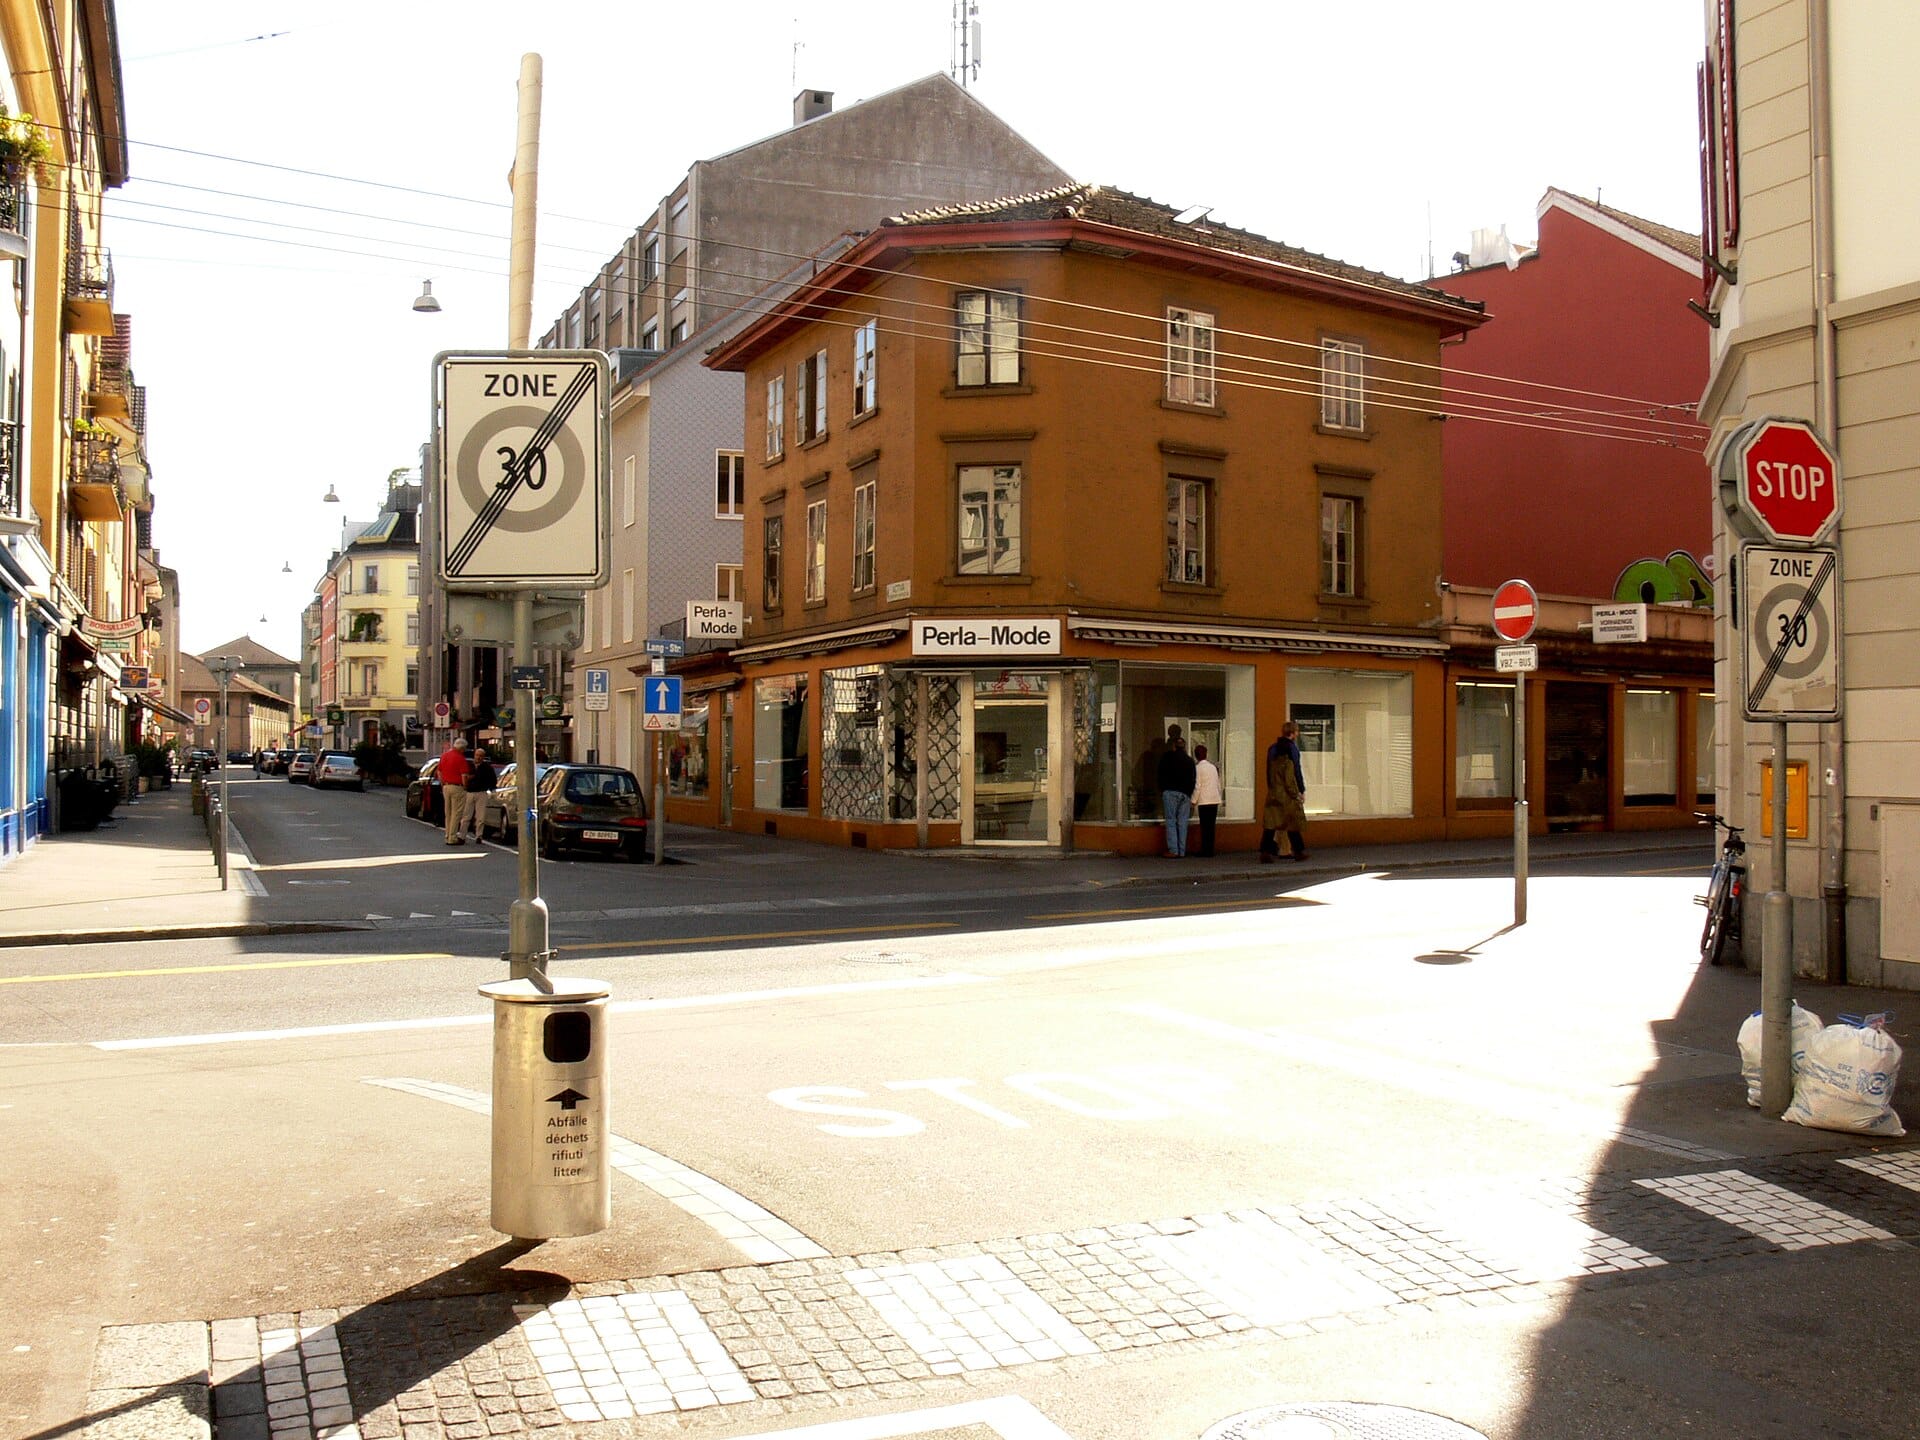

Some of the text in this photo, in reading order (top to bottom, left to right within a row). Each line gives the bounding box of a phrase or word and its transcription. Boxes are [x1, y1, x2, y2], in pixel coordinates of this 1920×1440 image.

[484, 374, 557, 397] ZONE
[496, 446, 547, 491] 30
[1756, 460, 1825, 502] STOP
[1770, 558, 1813, 577] ZONE
[693, 605, 734, 620] Perla-
[700, 620, 737, 635] Mode
[1777, 613, 1808, 648] 30
[593, 672, 601, 683] P
[547, 1115, 588, 1127] Abfälle
[545, 1133, 589, 1144] déchets
[551, 1149, 583, 1161] rifiuti
[553, 1166, 583, 1178] litter
